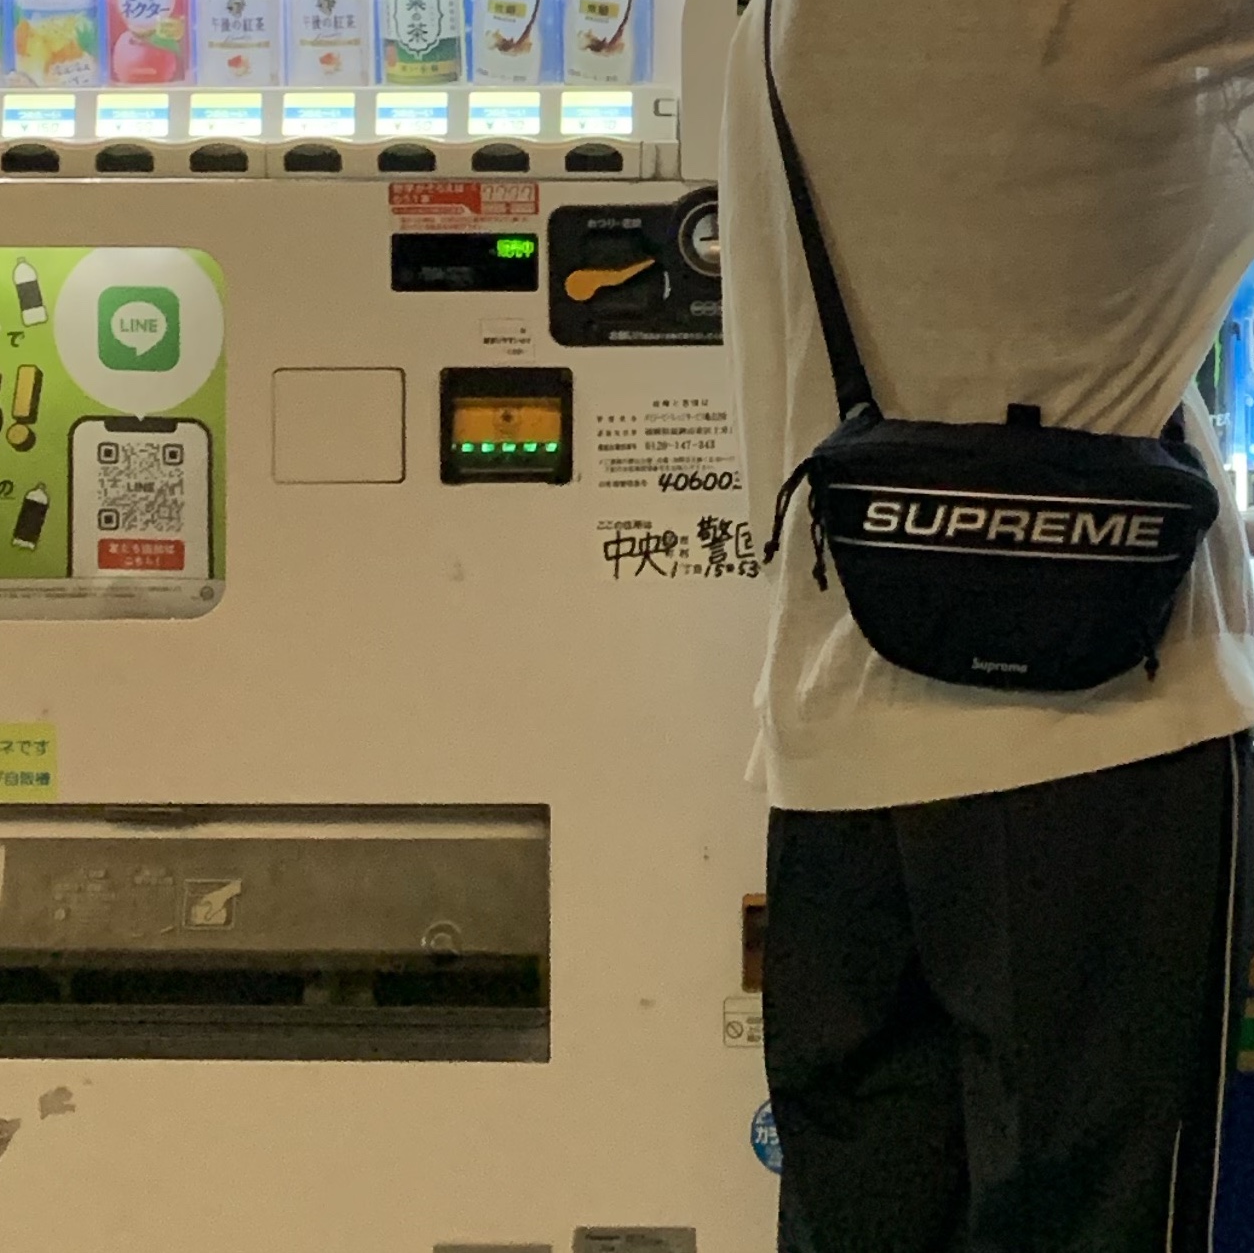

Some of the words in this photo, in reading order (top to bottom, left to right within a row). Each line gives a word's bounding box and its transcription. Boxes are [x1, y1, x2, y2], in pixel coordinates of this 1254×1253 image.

[121, 2, 170, 19] ネクター
[211, 15, 265, 33] 午後の紅茶
[303, 13, 356, 31] 午後の紅茶
[119, 318, 158, 334] LINE
[128, 482, 155, 493] LINE
[863, 501, 1165, 548] SUPREME
[972, 657, 1028, 674] Supreme
